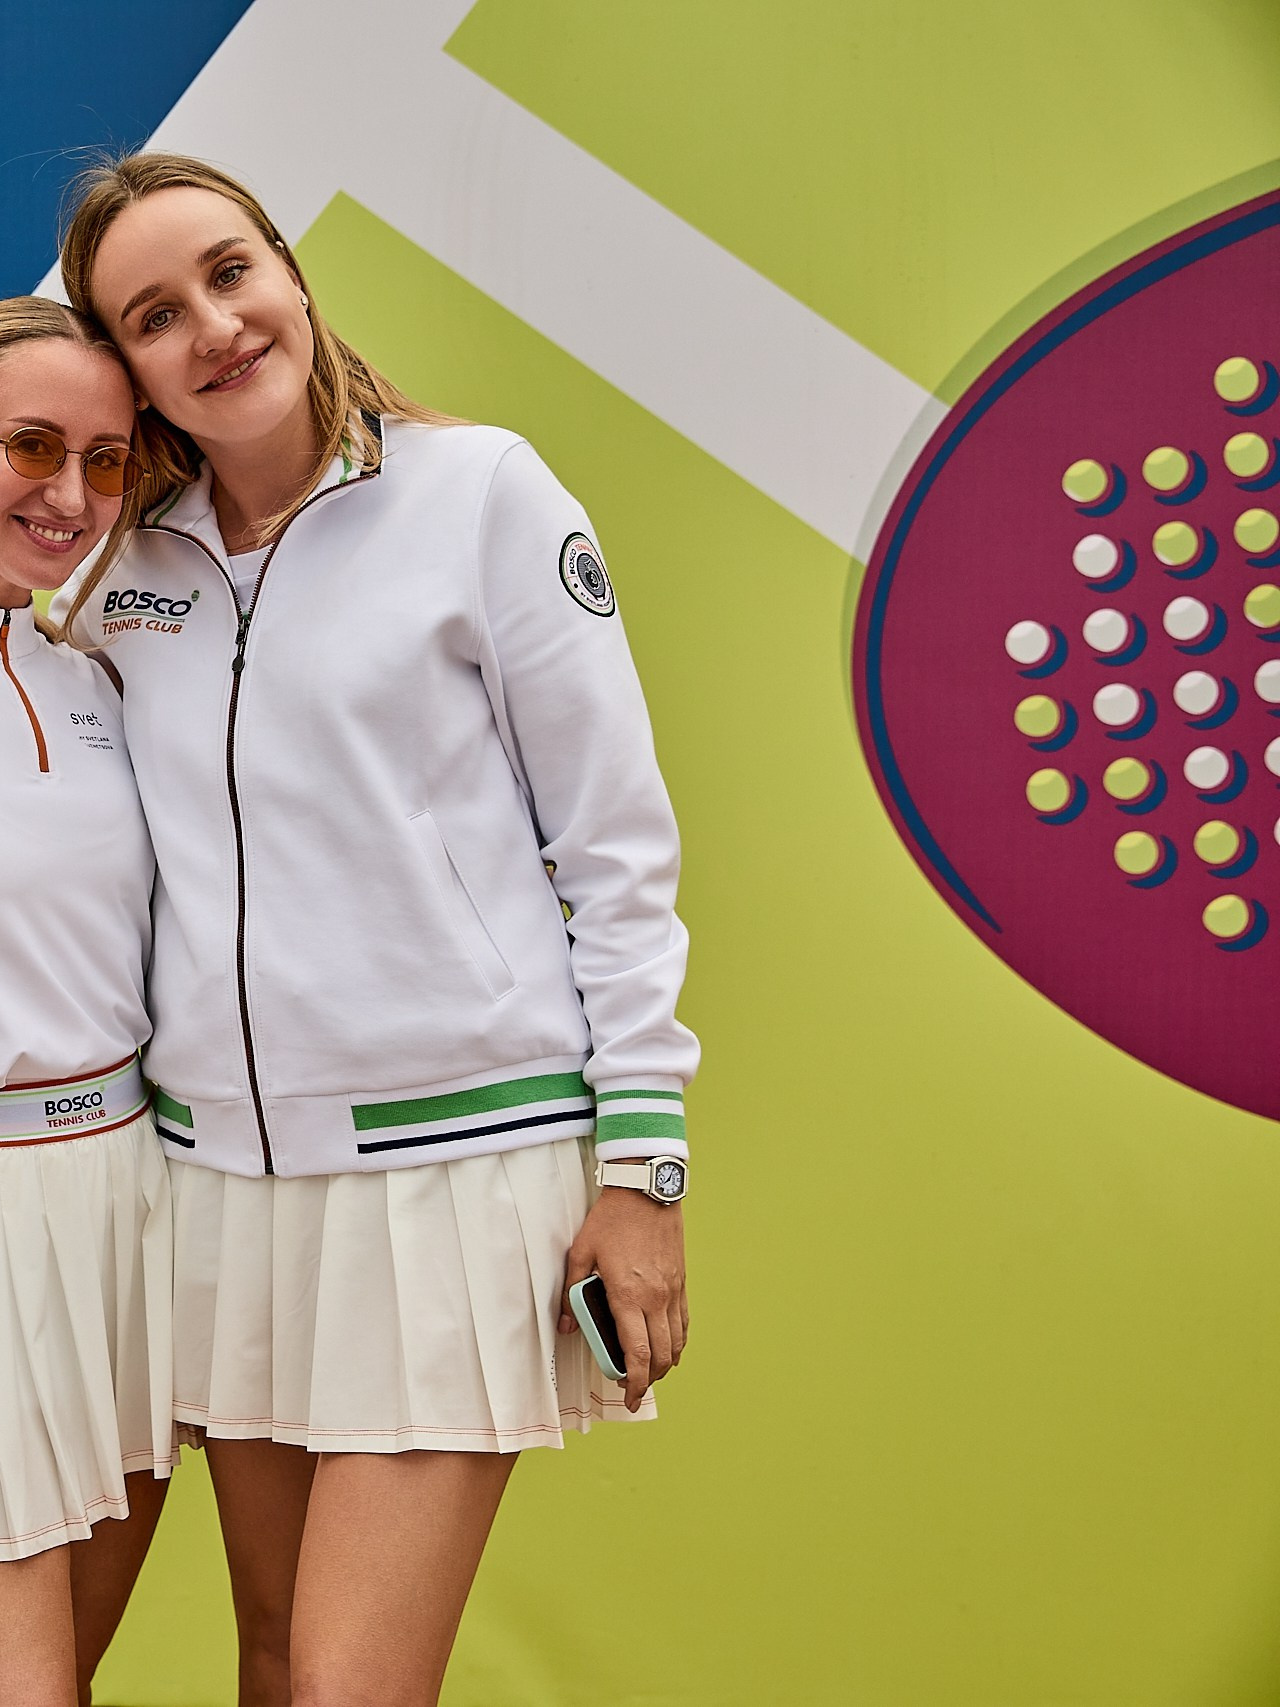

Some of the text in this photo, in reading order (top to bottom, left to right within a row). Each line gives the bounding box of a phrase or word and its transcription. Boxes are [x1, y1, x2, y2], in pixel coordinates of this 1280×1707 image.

[103, 589, 192, 616] BOSCO
[102, 618, 183, 635] TENNIS CLUB
[70, 712, 102, 726] svet
[45, 1091, 103, 1116] BOSCO
[47, 1109, 106, 1127] TENNIS CLUB
